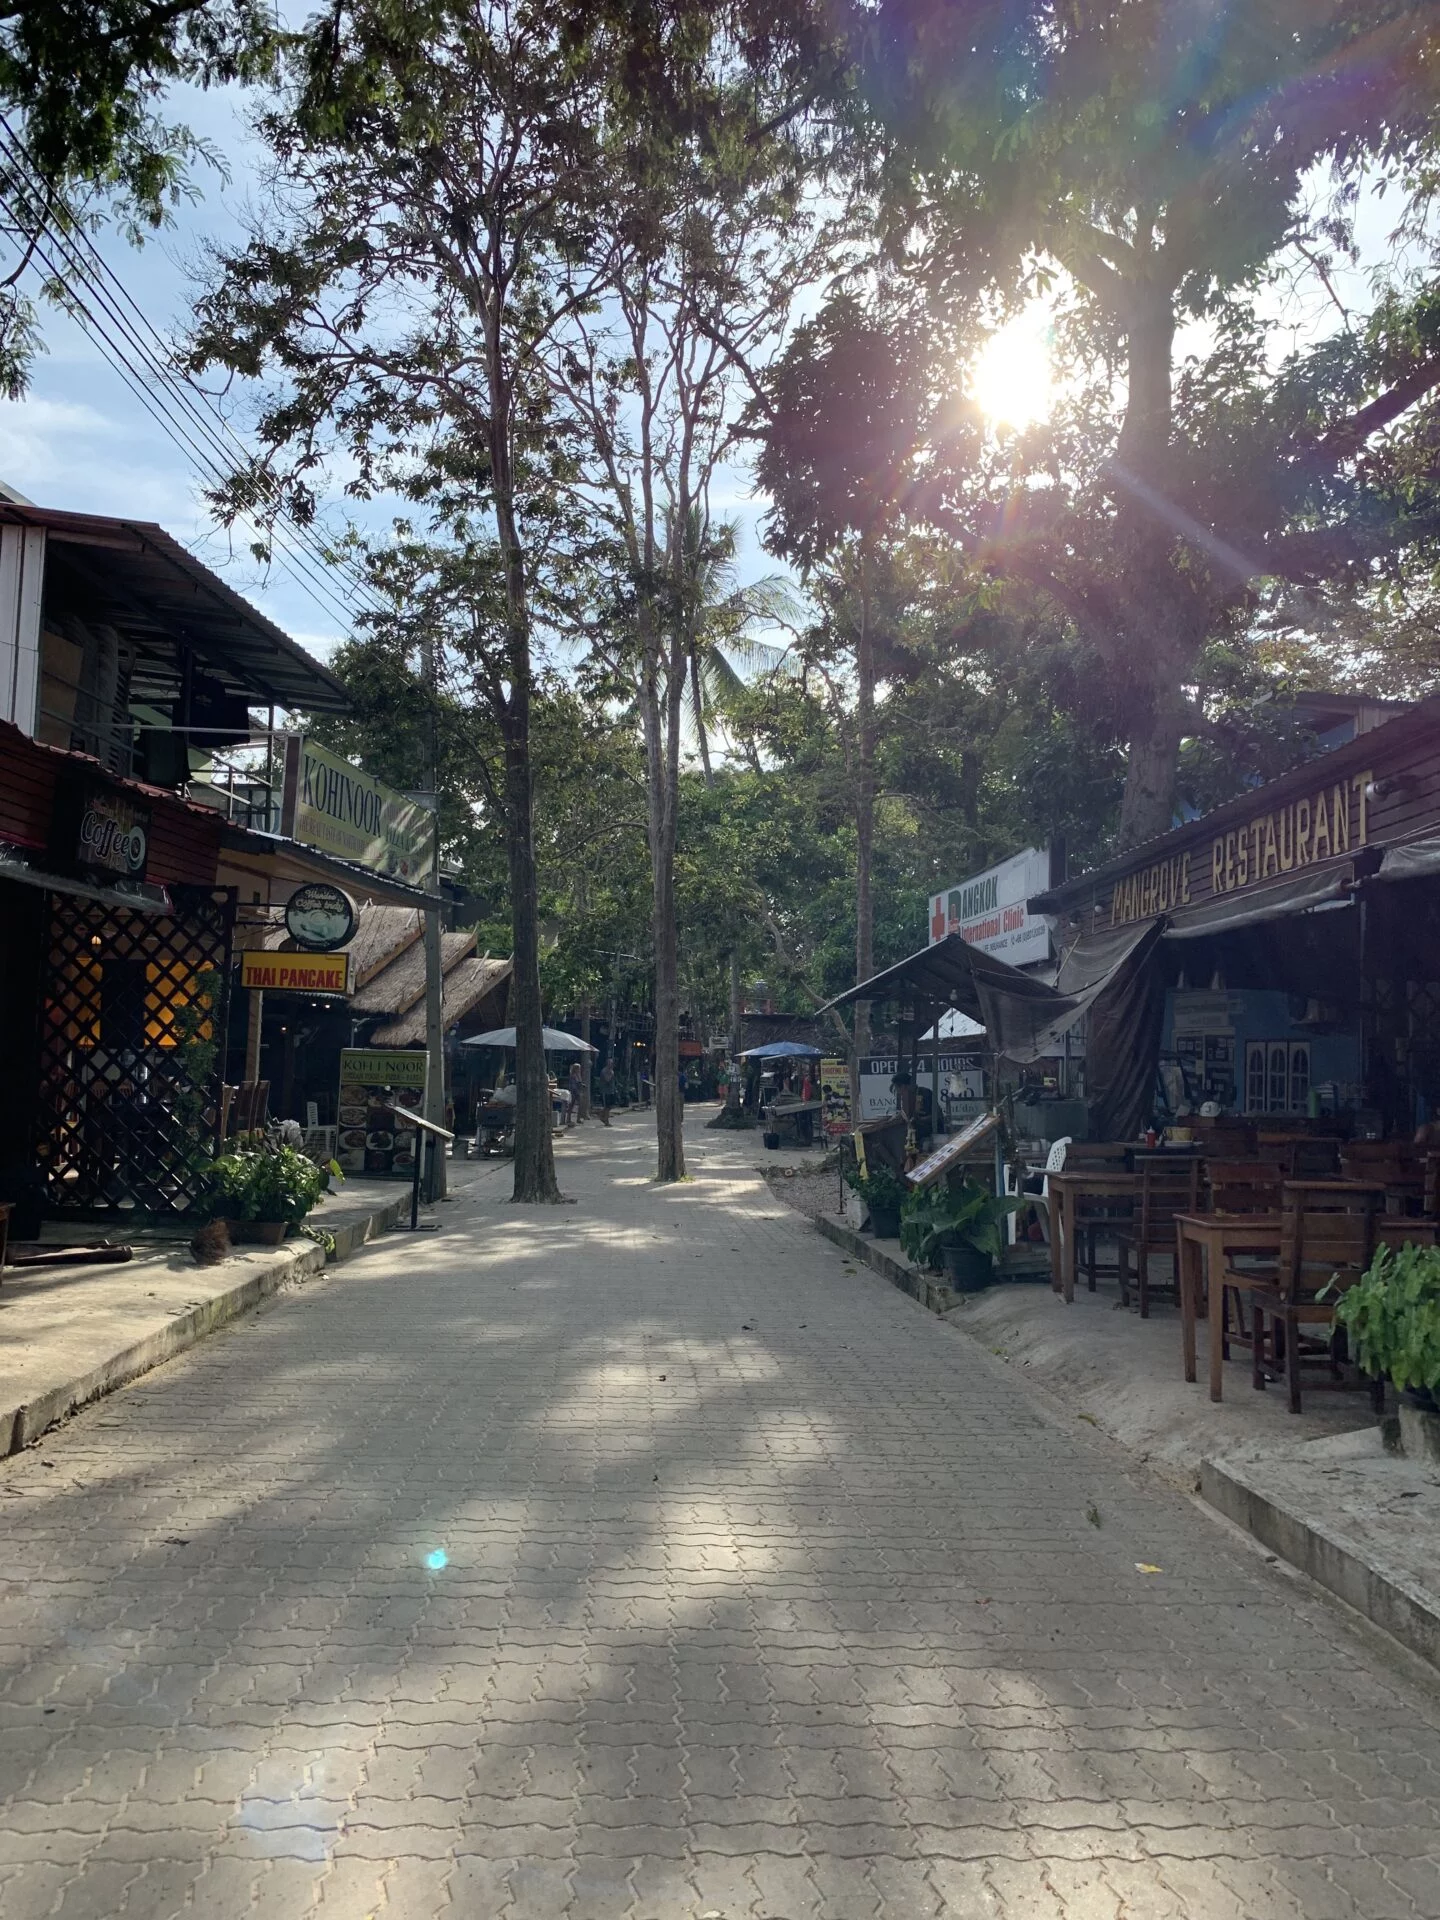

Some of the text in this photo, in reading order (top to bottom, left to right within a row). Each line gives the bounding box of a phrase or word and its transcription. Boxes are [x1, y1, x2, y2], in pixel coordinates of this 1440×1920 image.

[303, 754, 382, 838] KOHINOOR
[80, 810, 130, 858] Coffee
[1111, 769, 1374, 927] MANGROVE RESTAURANT
[961, 914, 1001, 944] International
[1003, 905, 1025, 932] Clinic
[246, 967, 343, 989] THAI PANCAKE
[344, 1060, 372, 1071] KOH
[385, 1062, 423, 1072] NOOR
